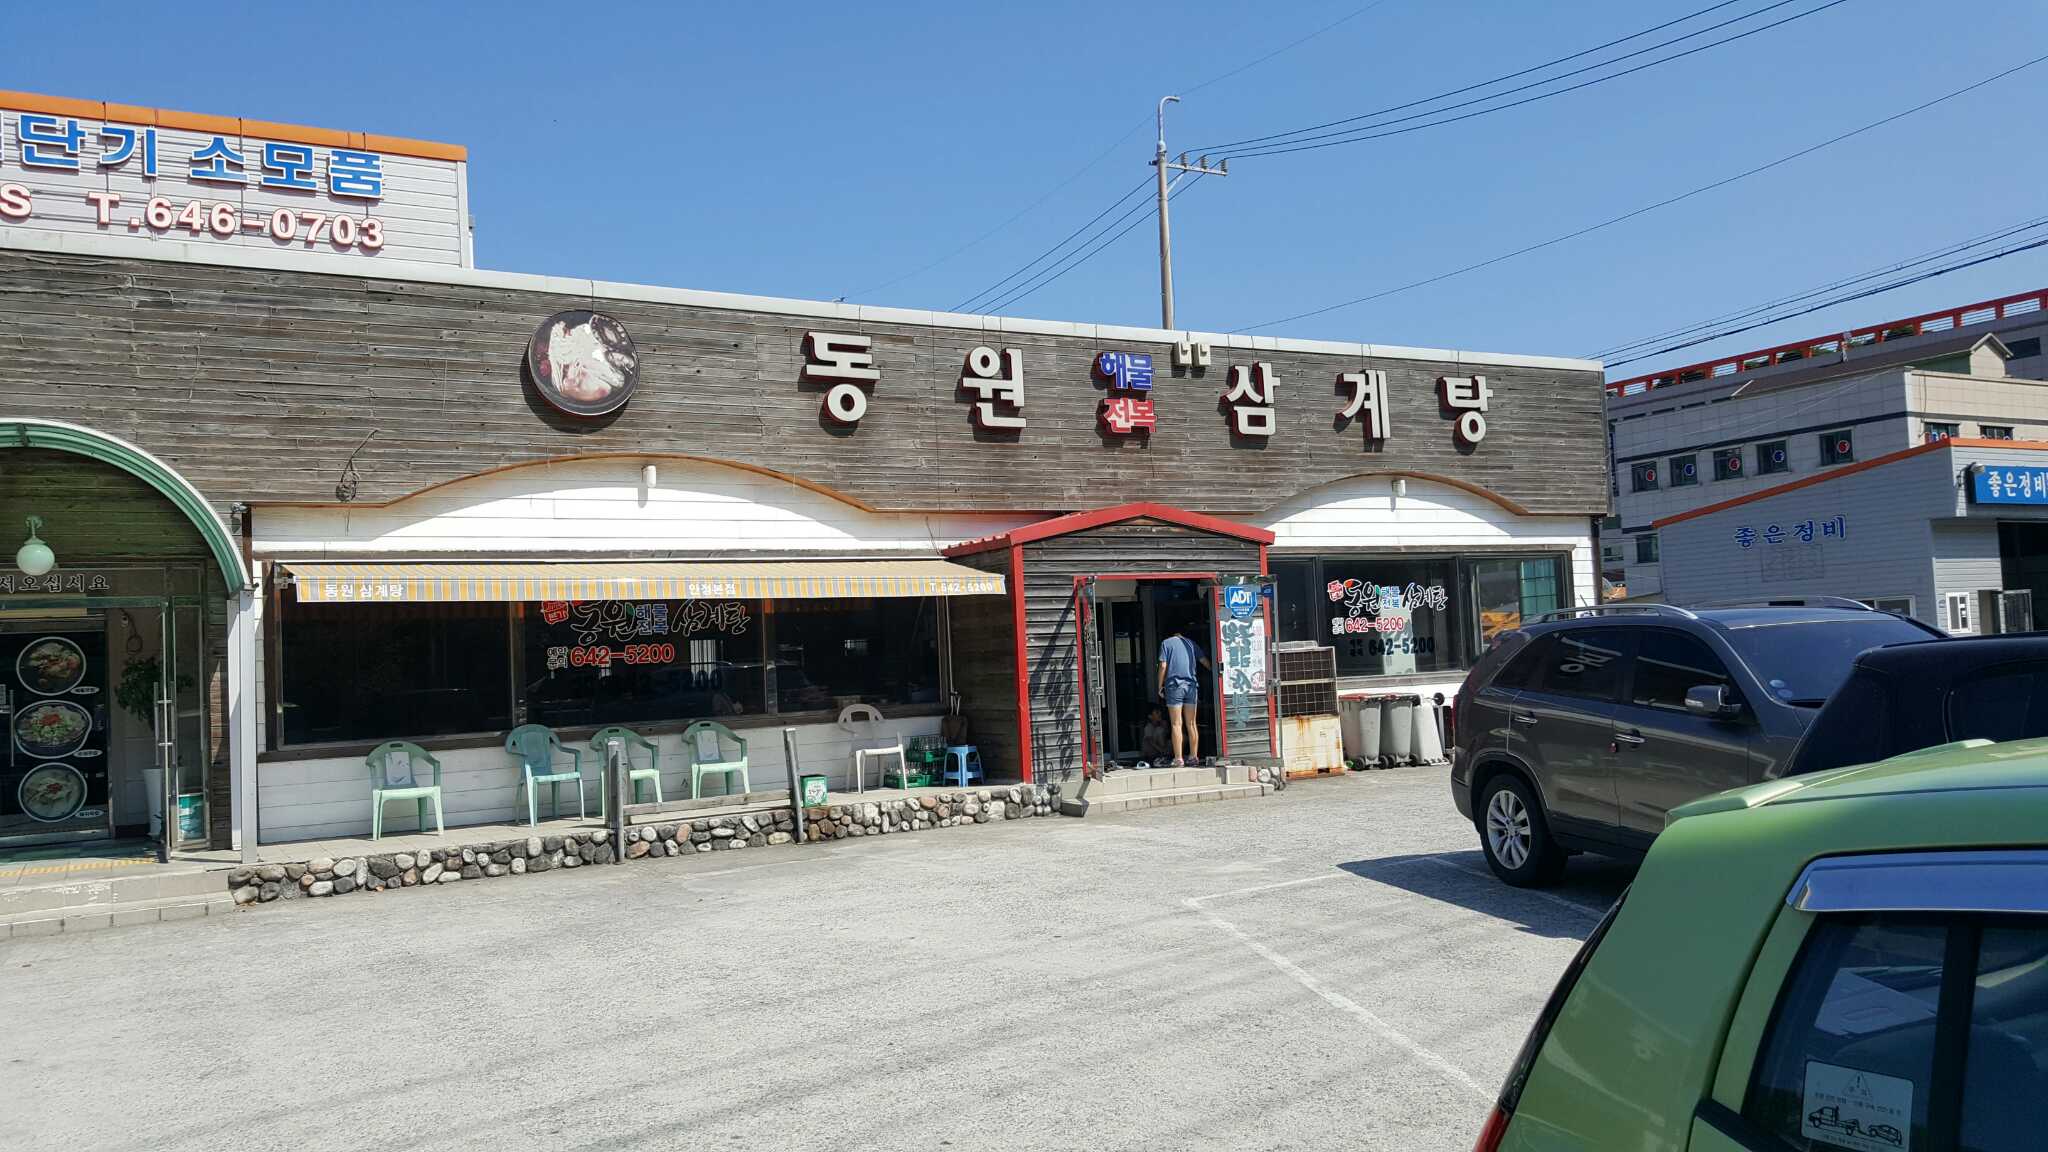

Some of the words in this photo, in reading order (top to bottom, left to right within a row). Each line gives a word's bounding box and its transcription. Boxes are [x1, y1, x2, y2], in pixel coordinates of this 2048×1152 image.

[0, 110, 159, 178] 단기
[190, 135, 383, 199] 소모품
[87, 191, 385, 249] T.646-0703
[803, 331, 1027, 428] 동원
[1100, 352, 1152, 390] 해물
[1225, 361, 1494, 443] 삼계탕
[1103, 398, 1157, 433] 전복
[1987, 471, 2048, 499] 좋은정비
[1735, 515, 1846, 549] 좋은정비
[325, 583, 354, 598] 동원
[360, 583, 404, 598] 삼계탕
[1231, 590, 1252, 604] ADT
[1345, 616, 1405, 633] 642-5200
[570, 643, 675, 667] 642-5200
